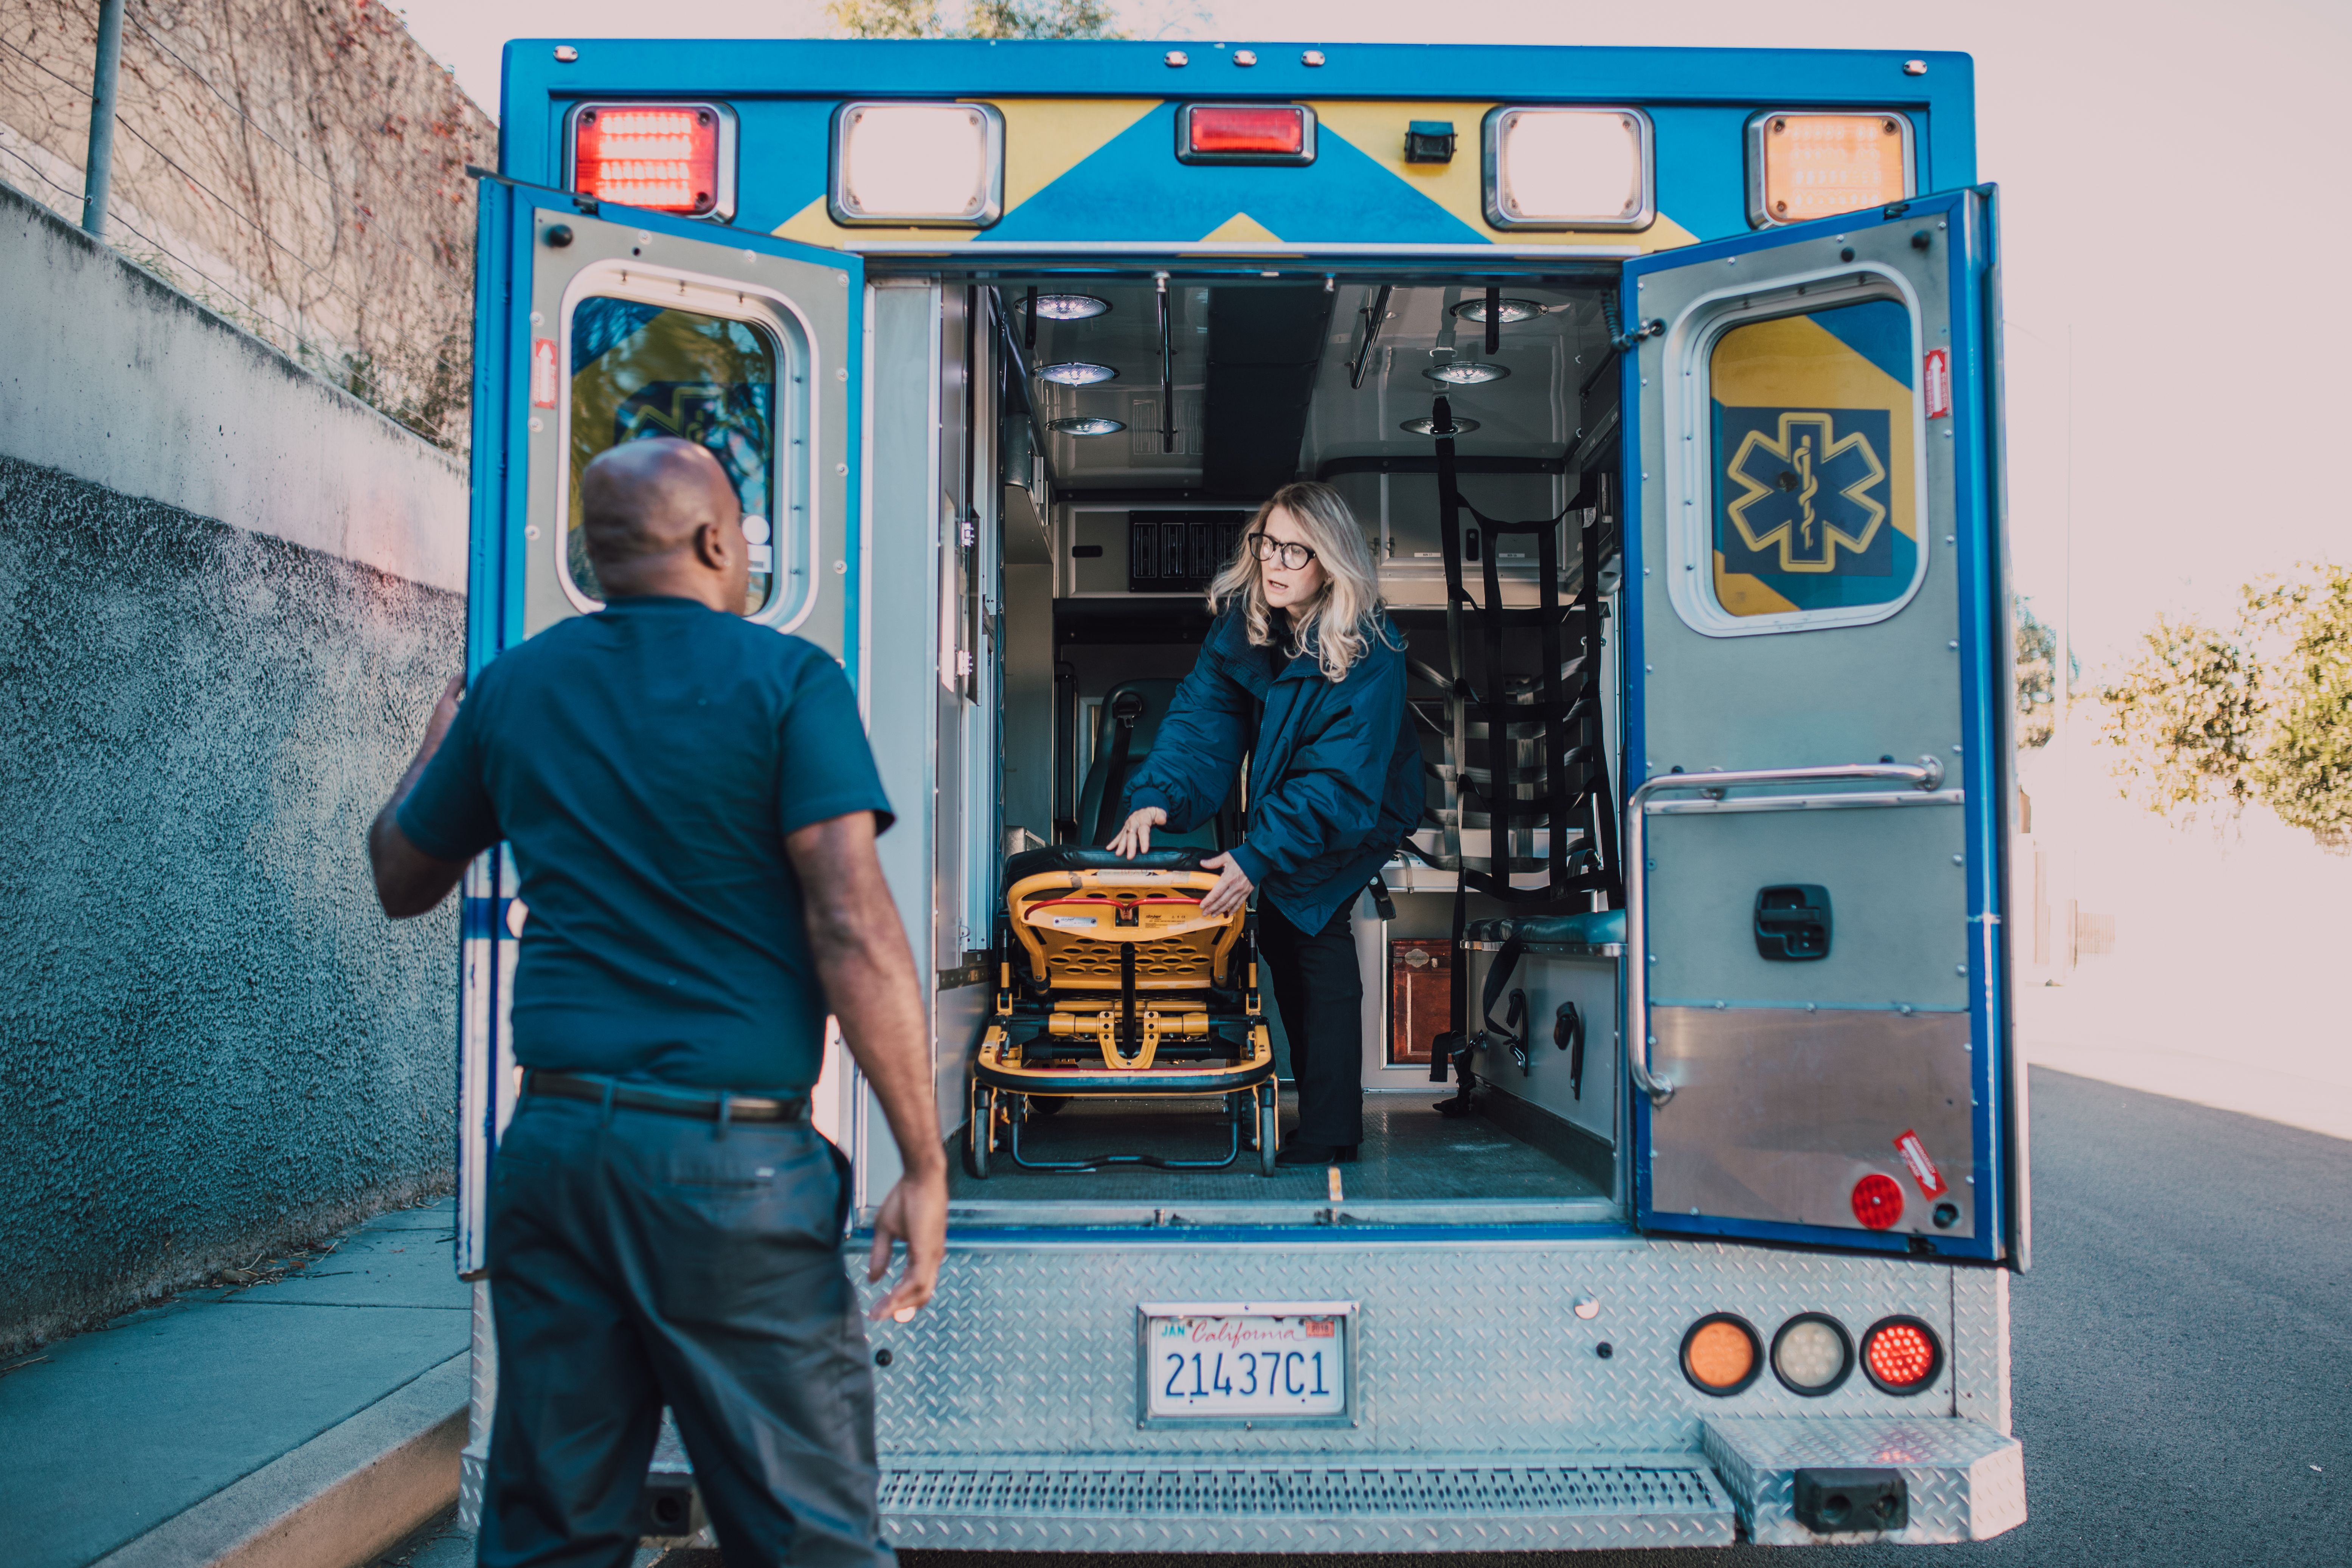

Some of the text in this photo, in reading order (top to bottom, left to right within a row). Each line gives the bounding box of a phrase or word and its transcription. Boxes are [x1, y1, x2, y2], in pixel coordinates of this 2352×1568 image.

[1901, 1149, 1922, 1178] RELEASE
[1911, 1136, 1936, 1174] EMERGENCY
[1162, 1325, 1185, 1338] JAN
[1192, 1320, 1307, 1349] California
[1166, 1351, 1329, 1396] 21437C1
